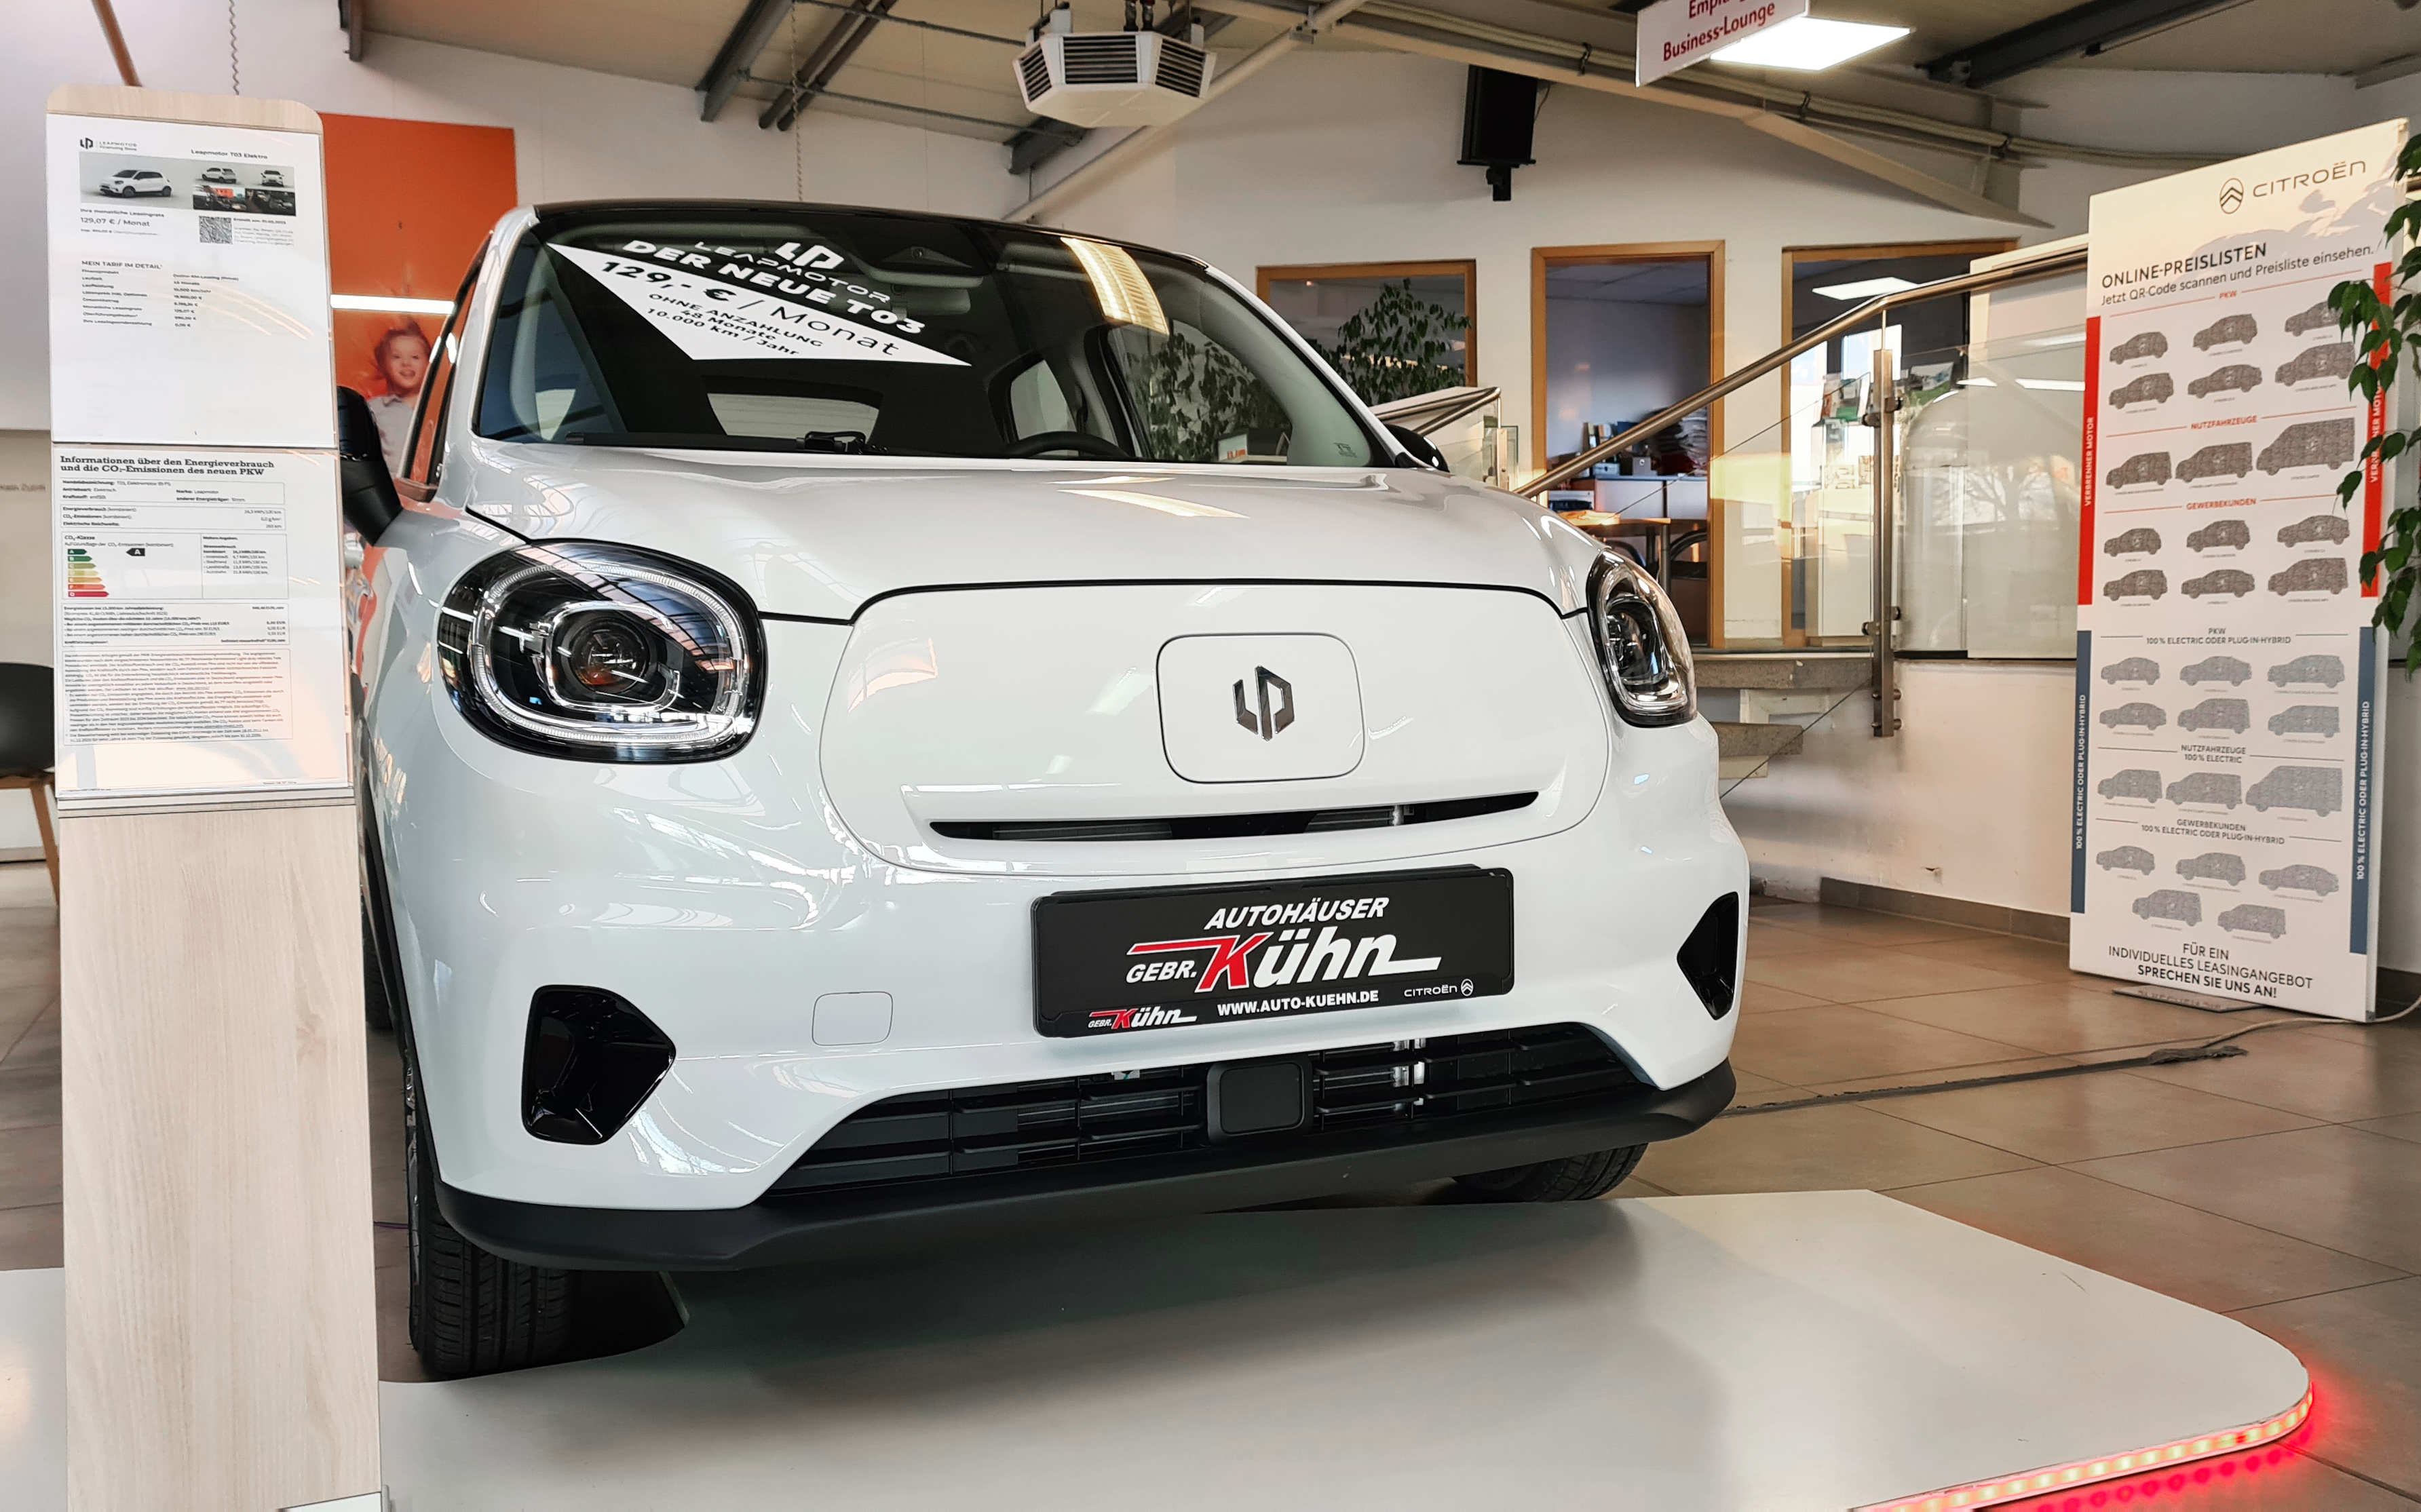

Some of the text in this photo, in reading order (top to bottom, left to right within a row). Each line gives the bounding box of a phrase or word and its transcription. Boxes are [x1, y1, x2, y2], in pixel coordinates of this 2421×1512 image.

[1663, 3, 1775, 61] Business-Lounge
[2253, 161, 2366, 197] CITROËN
[694, 241, 890, 303] LEAPMOTOR
[2101, 243, 2266, 288] ONLINE-PREISLISTEN
[2101, 246, 2374, 306] Jetzt QR-Code scannen und Preisliste einsehen.
[622, 240, 926, 334] DER NEUE T03
[2219, 290, 2238, 300] PKW
[648, 309, 705, 327] 10.000
[710, 326, 739, 338] km
[756, 339, 799, 355] Jahr
[649, 294, 824, 347] OHNE ANZAHLUNG
[681, 310, 776, 341] 48 Monate
[703, 288, 737, 302] €
[737, 300, 765, 310] /
[770, 306, 899, 355] Monat
[2086, 416, 2094, 449] MOTOR
[2191, 415, 2257, 429] NUTZFAHRZEUGE
[60, 456, 135, 465] Informationen
[185, 459, 274, 468] Energieverbrauch
[2084, 452, 2093, 507] VERBRENNER
[2186, 498, 2256, 511] GEWERBEKUNDEN
[2228, 636, 2291, 644] PLUG-IN-HYBRID
[2078, 695, 2086, 760] PLUG-IN-HYBRID
[2360, 701, 2370, 777] PLUG-IN-HYBRID
[2181, 744, 2246, 754] NUTZFAHRZEUGE
[2207, 754, 2243, 763] ELECTRIC
[2359, 779, 2367, 807] ODER
[2141, 824, 2153, 832] 100
[2162, 826, 2198, 836] ELECTRIC
[2200, 830, 2219, 838] ODER
[2222, 832, 2285, 845] PLUG-IN-HYBRID
[2177, 819, 2246, 832] GEWERBEKUNDEN
[2357, 808, 2367, 854] ELECTRIC
[2356, 865, 2365, 880] 100
[1204, 897, 1389, 930] AUTOHÄUSER
[1126, 926, 1442, 993] GEBR. Kühn
[2109, 946, 2313, 988] INDIVIDUELLES LEASINGANGEBOT
[2183, 942, 2229, 960] FÜR EIN
[1404, 984, 1457, 997] CITROËN
[2138, 965, 2277, 999] SPRECHEN SIE UNS AN!
[1088, 1006, 1198, 1030] GEBR. Kühn
[1217, 990, 1379, 1016] WWW.AUTO-KUEHN.DE
